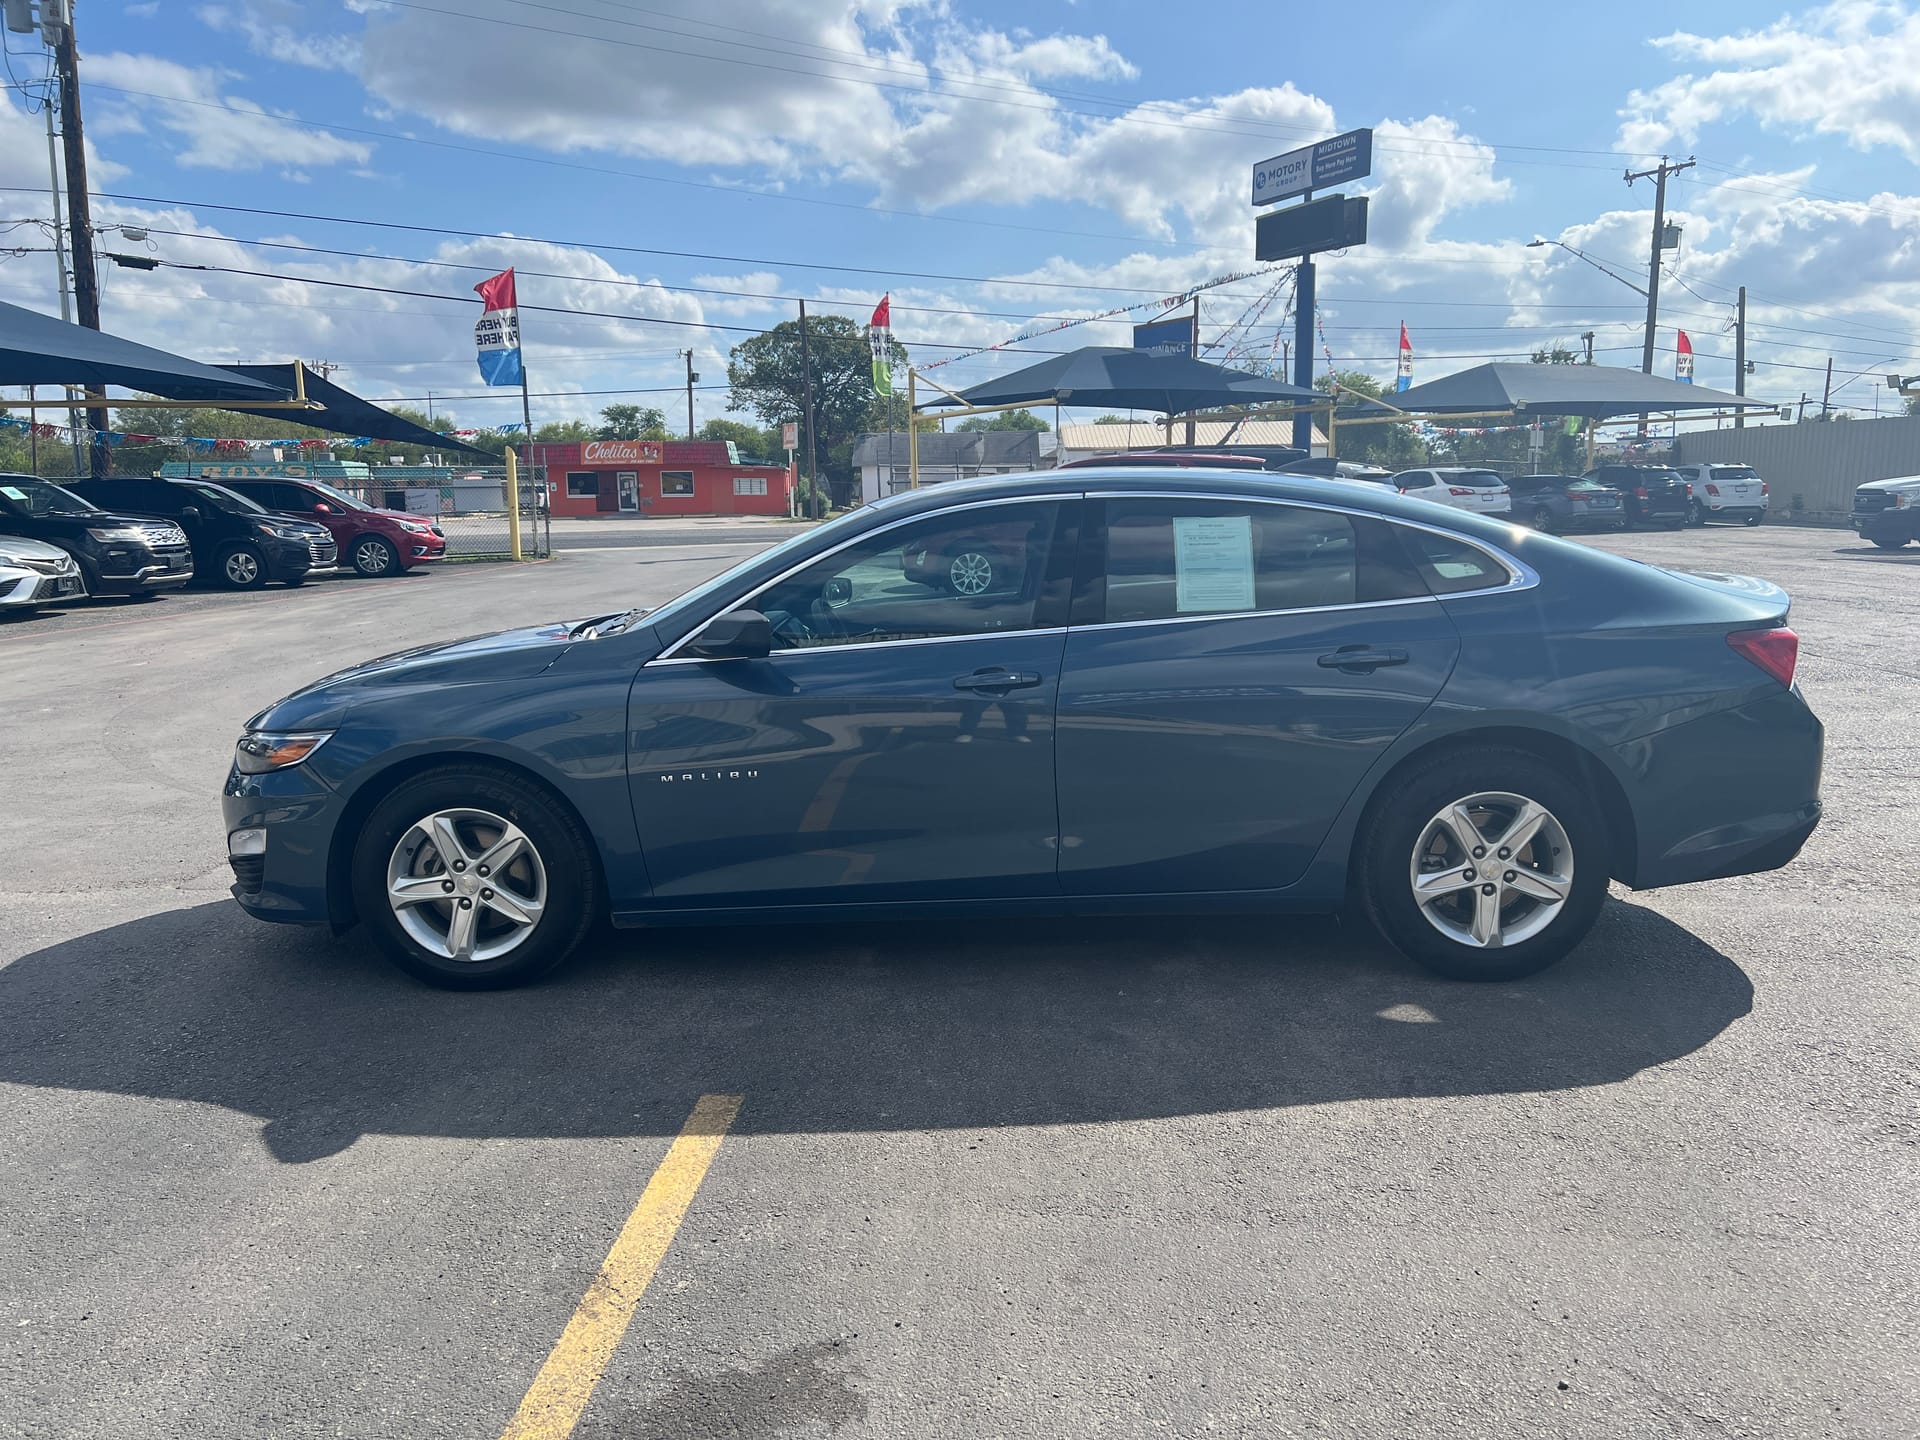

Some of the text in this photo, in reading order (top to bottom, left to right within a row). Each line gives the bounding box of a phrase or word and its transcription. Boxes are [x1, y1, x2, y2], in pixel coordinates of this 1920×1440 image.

[1318, 135, 1357, 155] MIDTOWN
[1268, 159, 1308, 181] MOTORY
[1276, 175, 1298, 187] GROUP
[584, 441, 637, 460] Chelitas
[200, 465, 307, 477] ROY'S
[660, 770, 758, 782] MALIBU
